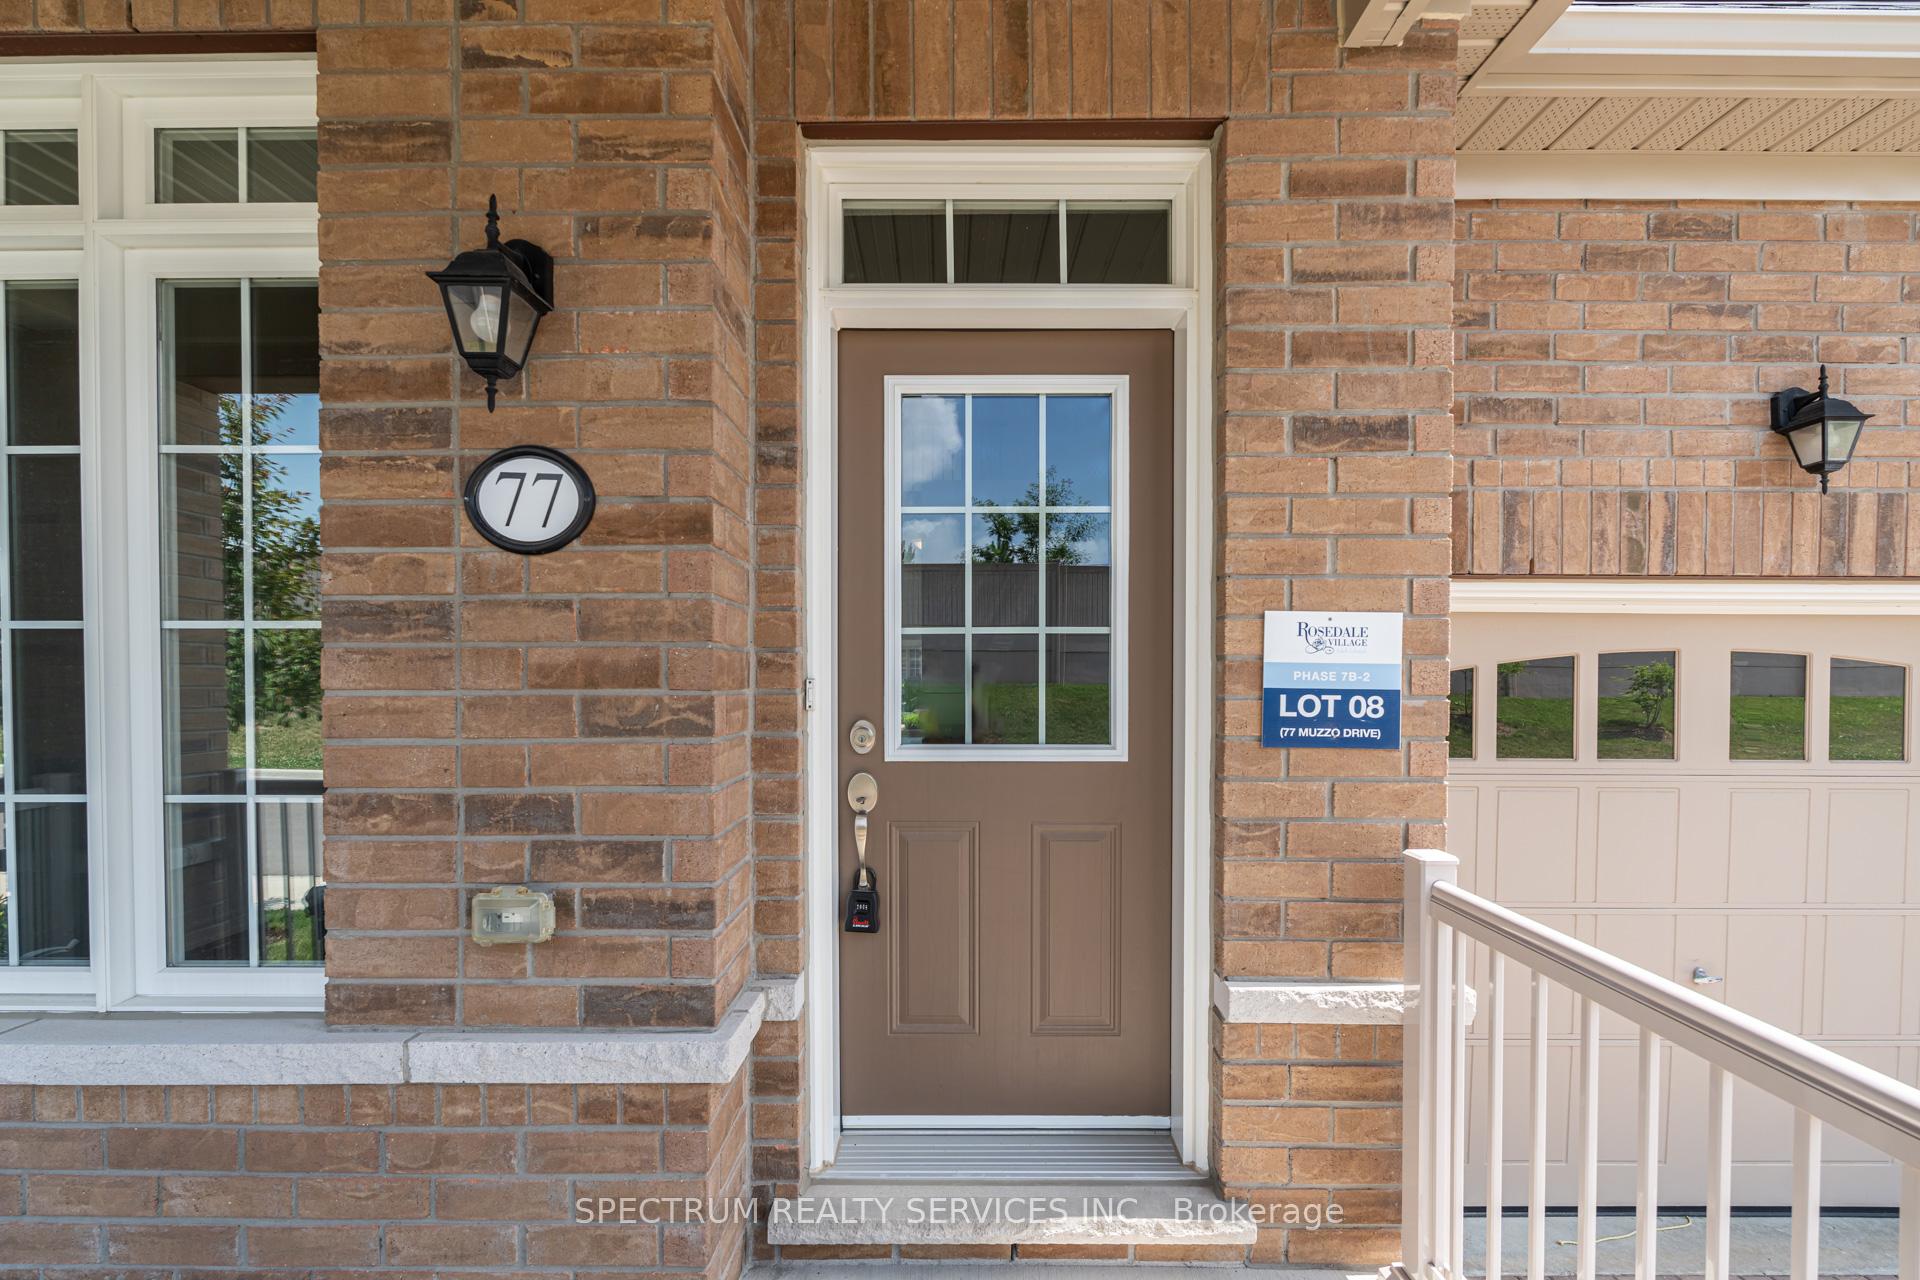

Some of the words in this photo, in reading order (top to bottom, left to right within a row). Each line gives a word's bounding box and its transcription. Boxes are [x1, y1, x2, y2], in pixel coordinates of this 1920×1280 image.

[495, 471, 564, 529] 77
[1297, 621, 1369, 641] ROSEDALE
[1327, 638, 1368, 647] VILLAGE
[1293, 671, 1337, 681] PHASE
[1341, 672, 1371, 682] 7B-2
[1279, 694, 1342, 718] LOT
[1349, 695, 1385, 719] 08
[1280, 727, 1295, 738] (77
[1298, 728, 1341, 738] MUZZO
[1343, 729, 1382, 740] DRIVE)
